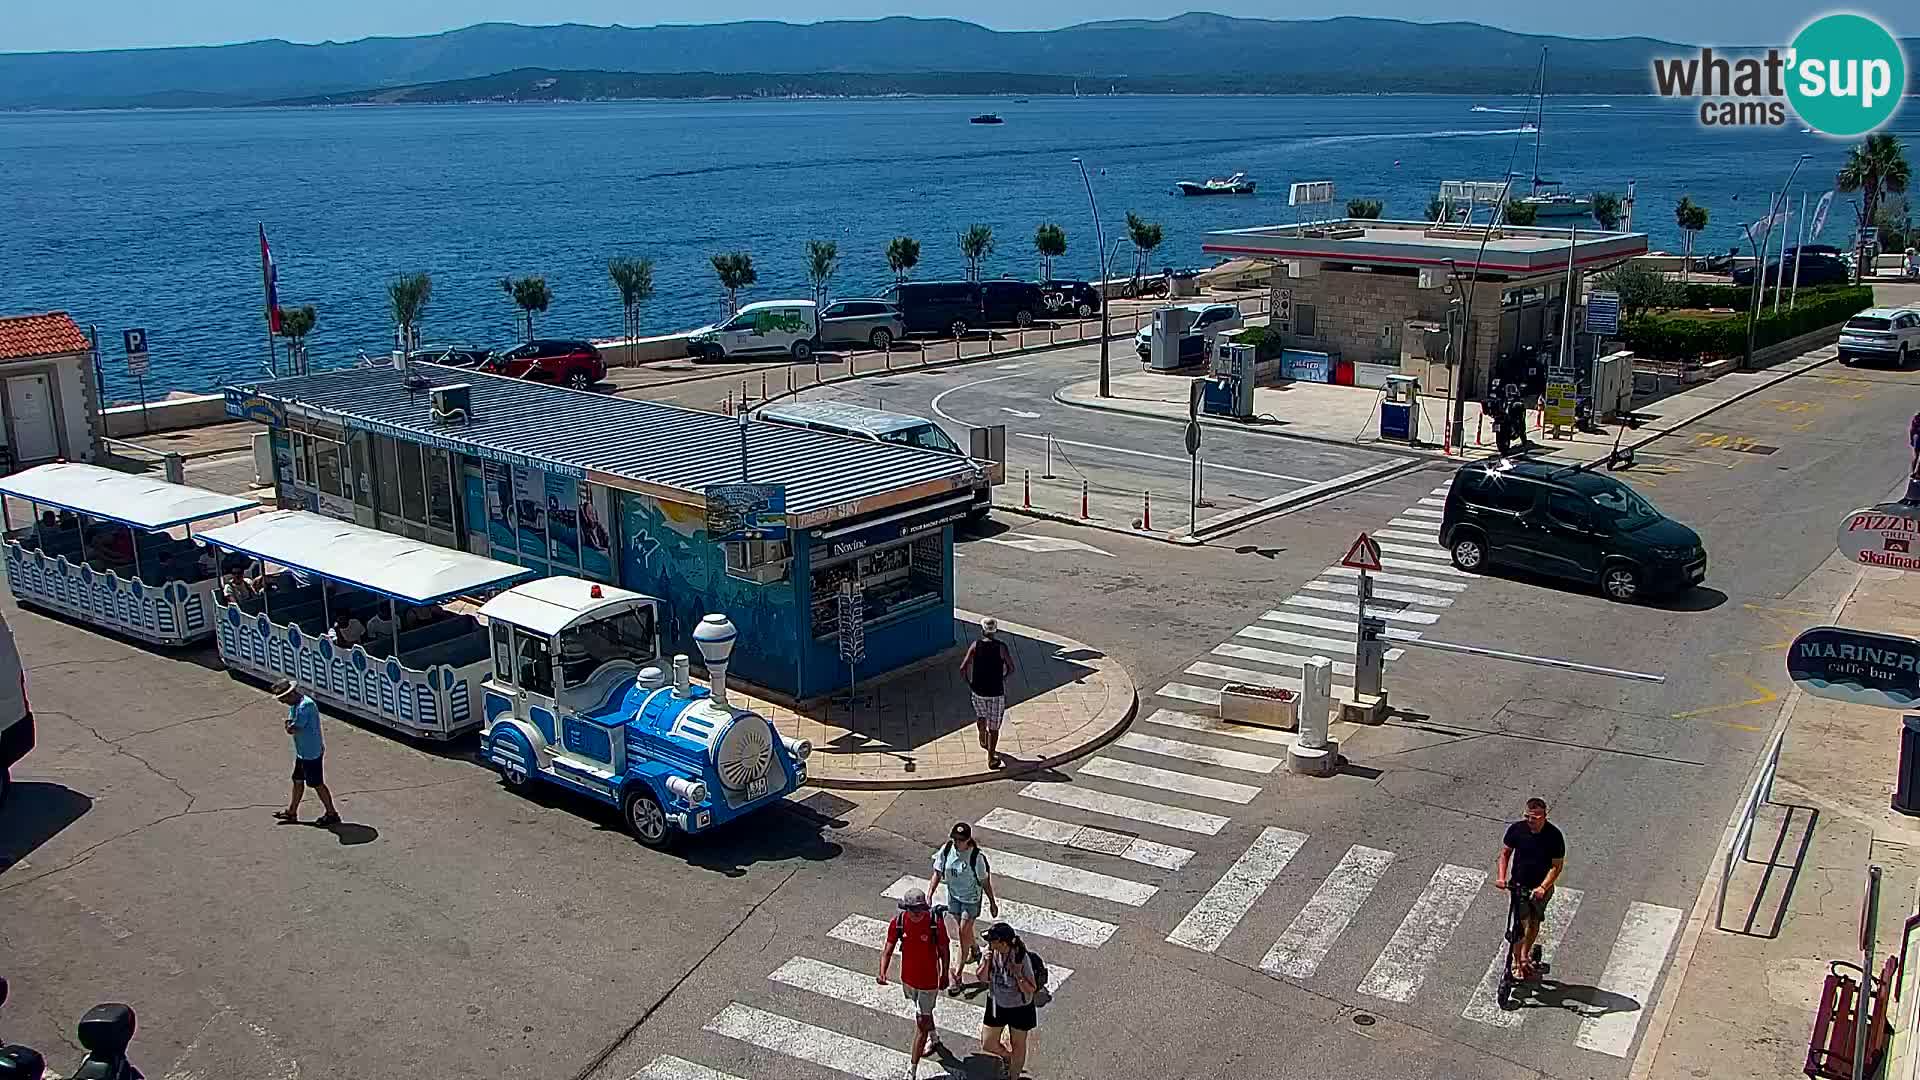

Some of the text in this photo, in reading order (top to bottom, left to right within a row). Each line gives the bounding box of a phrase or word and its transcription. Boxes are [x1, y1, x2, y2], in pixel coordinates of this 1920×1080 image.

[128, 332, 142, 351] P
[477, 446, 492, 458] BUS
[493, 450, 526, 466] STATION
[527, 458, 553, 473] TICKET
[554, 464, 582, 478] OFFICE
[1881, 530, 1916, 541] GRILL
[1828, 662, 1896, 681] caffe bar
